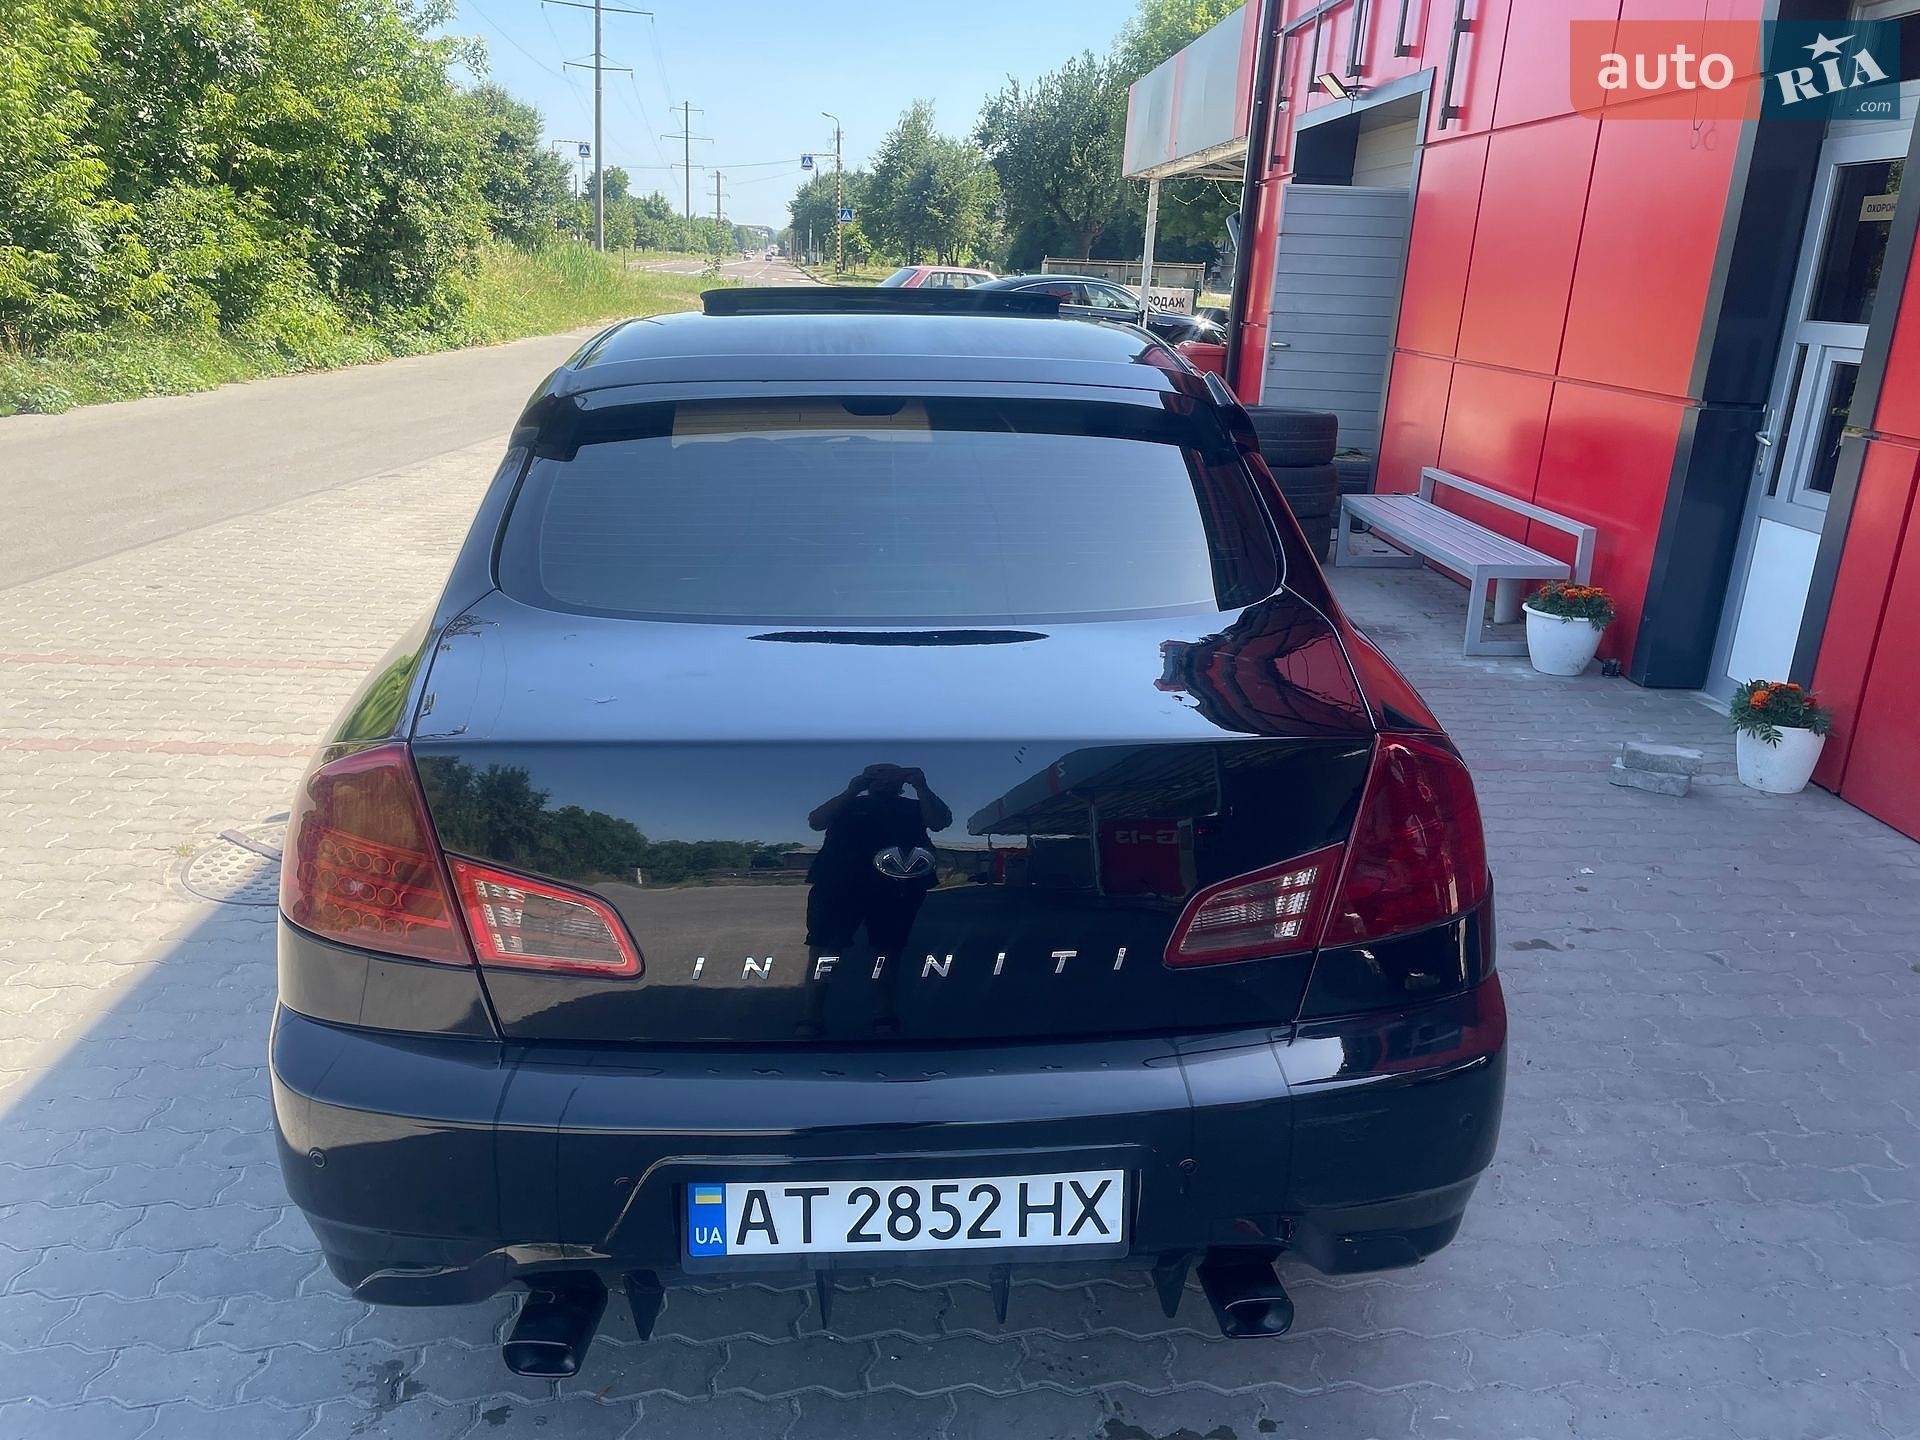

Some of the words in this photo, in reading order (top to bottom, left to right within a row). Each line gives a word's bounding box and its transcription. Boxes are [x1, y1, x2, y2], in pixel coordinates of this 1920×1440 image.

[691, 947, 1127, 981] INFINITI
[735, 1187, 830, 1246] AT
[846, 1184, 1002, 1244] 2852
[1017, 1179, 1113, 1238] HX
[694, 1227, 723, 1245] UA
